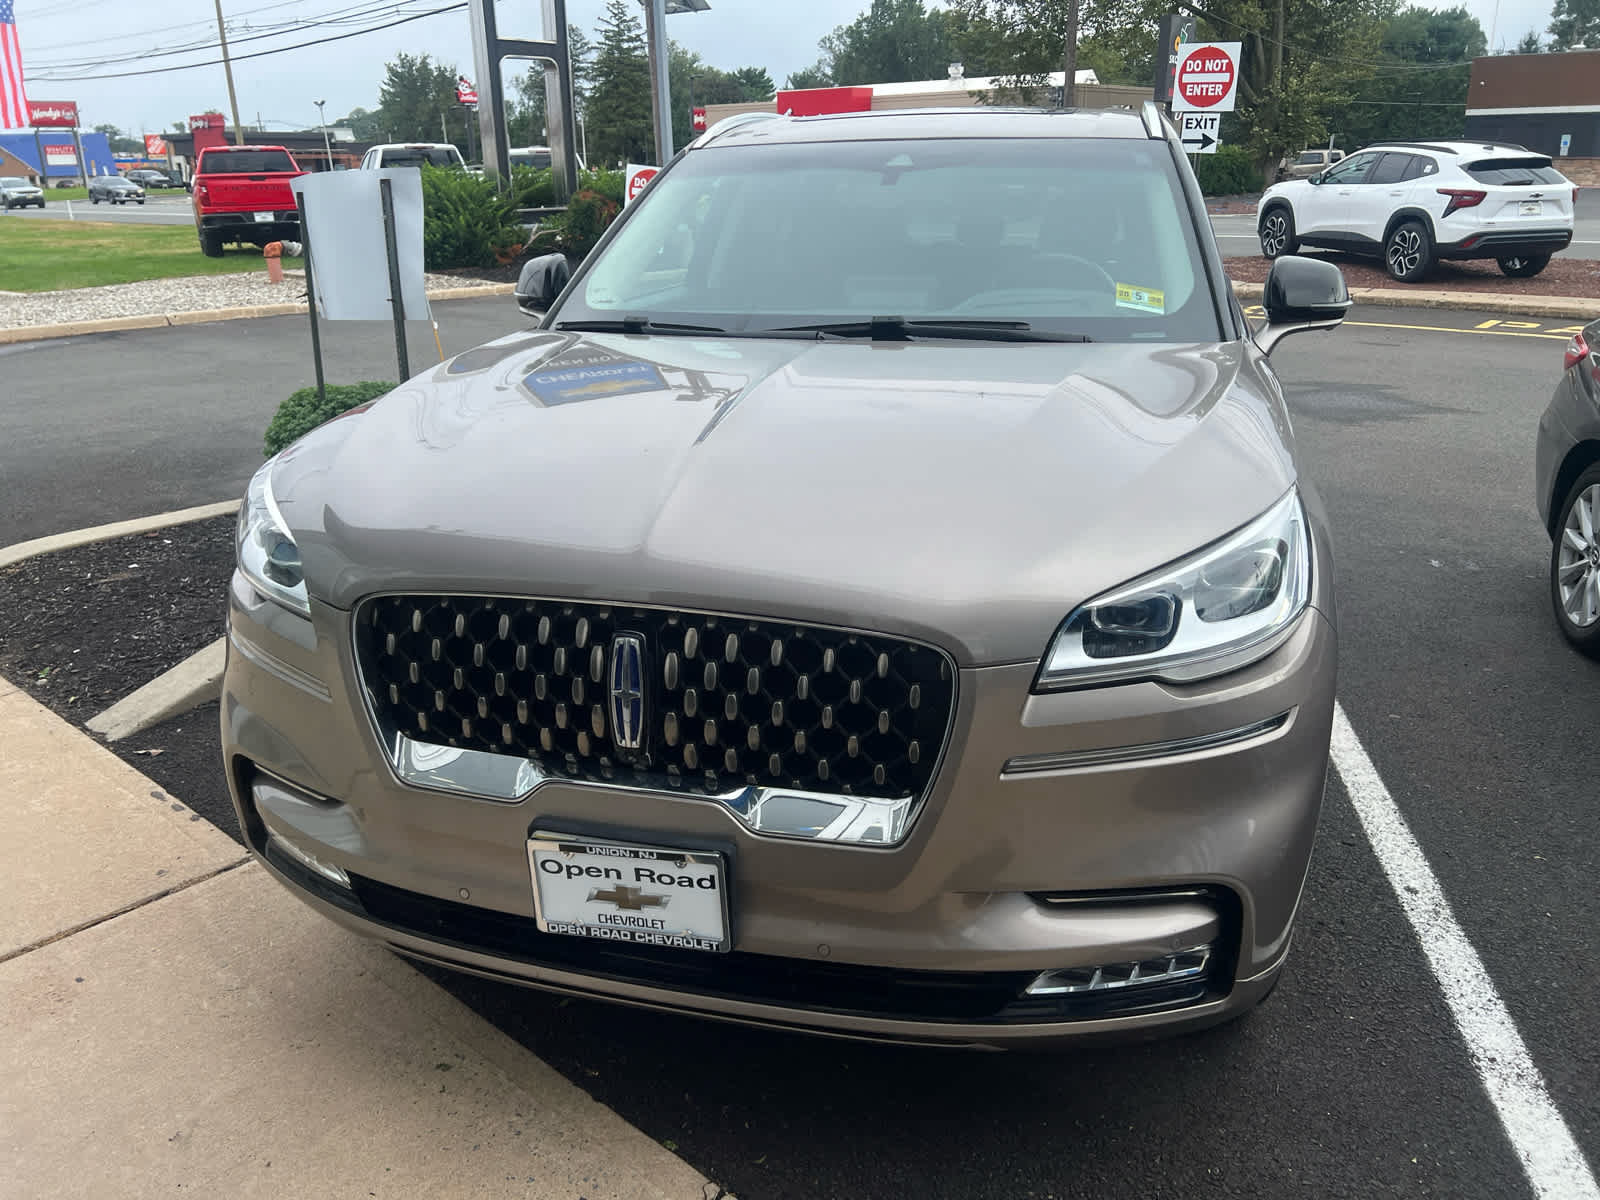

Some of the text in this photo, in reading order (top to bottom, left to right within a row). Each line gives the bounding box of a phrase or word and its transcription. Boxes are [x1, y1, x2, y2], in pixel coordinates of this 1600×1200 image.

[1186, 59, 1229, 72] DO NOT
[1186, 84, 1223, 96] ENTER
[1185, 117, 1217, 129] EXIT
[634, 177, 647, 187] DO
[639, 850, 657, 860] NJ
[540, 859, 717, 890] Open Road
[598, 913, 665, 930] CHEVROLET
[549, 923, 719, 951] OPEN ROAD CHEVROLET
